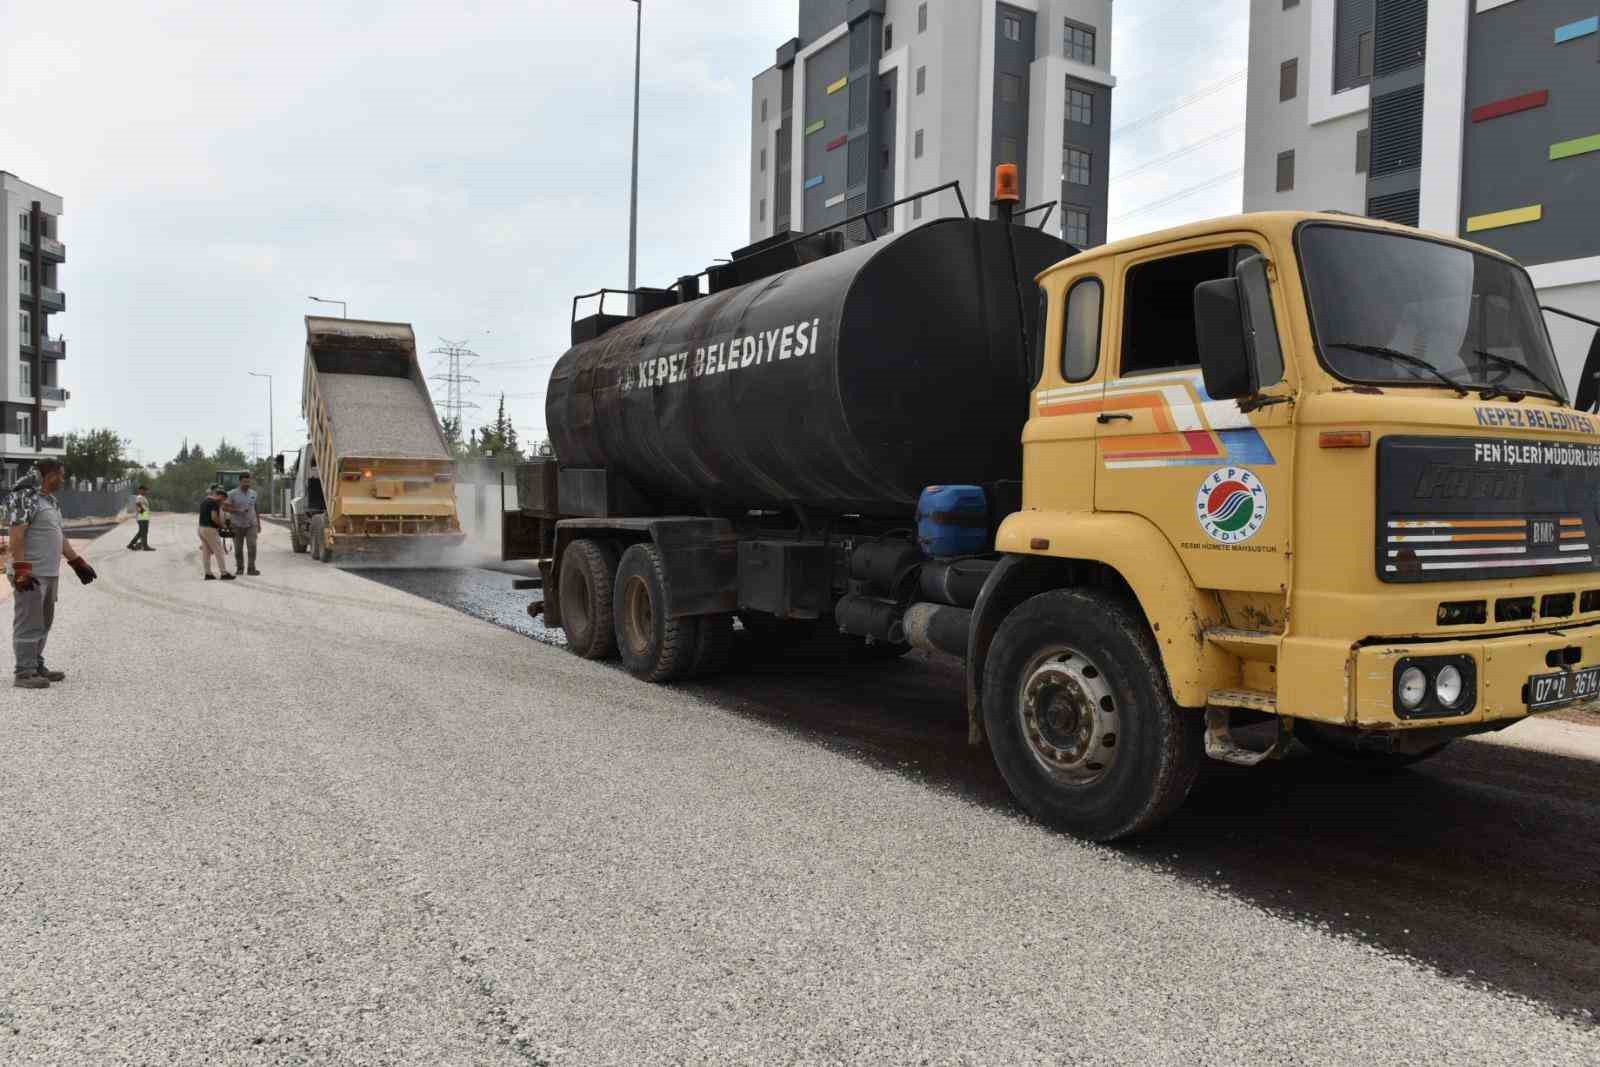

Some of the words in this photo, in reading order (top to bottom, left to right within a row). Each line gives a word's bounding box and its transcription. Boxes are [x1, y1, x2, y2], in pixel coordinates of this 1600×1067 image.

[638, 351, 688, 389] KEPEZ
[694, 318, 820, 377] BELEDİYESİ
[1474, 407, 1525, 427] KEPEZ
[1474, 443, 1501, 462] FEN
[1503, 440, 1542, 464] İŞLERİ
[1544, 442, 1600, 467] MÜDÜRLÜĞ
[1201, 469, 1263, 496] KEPEZ
[1533, 521, 1554, 543] BMC
[1536, 678, 1552, 701] 07
